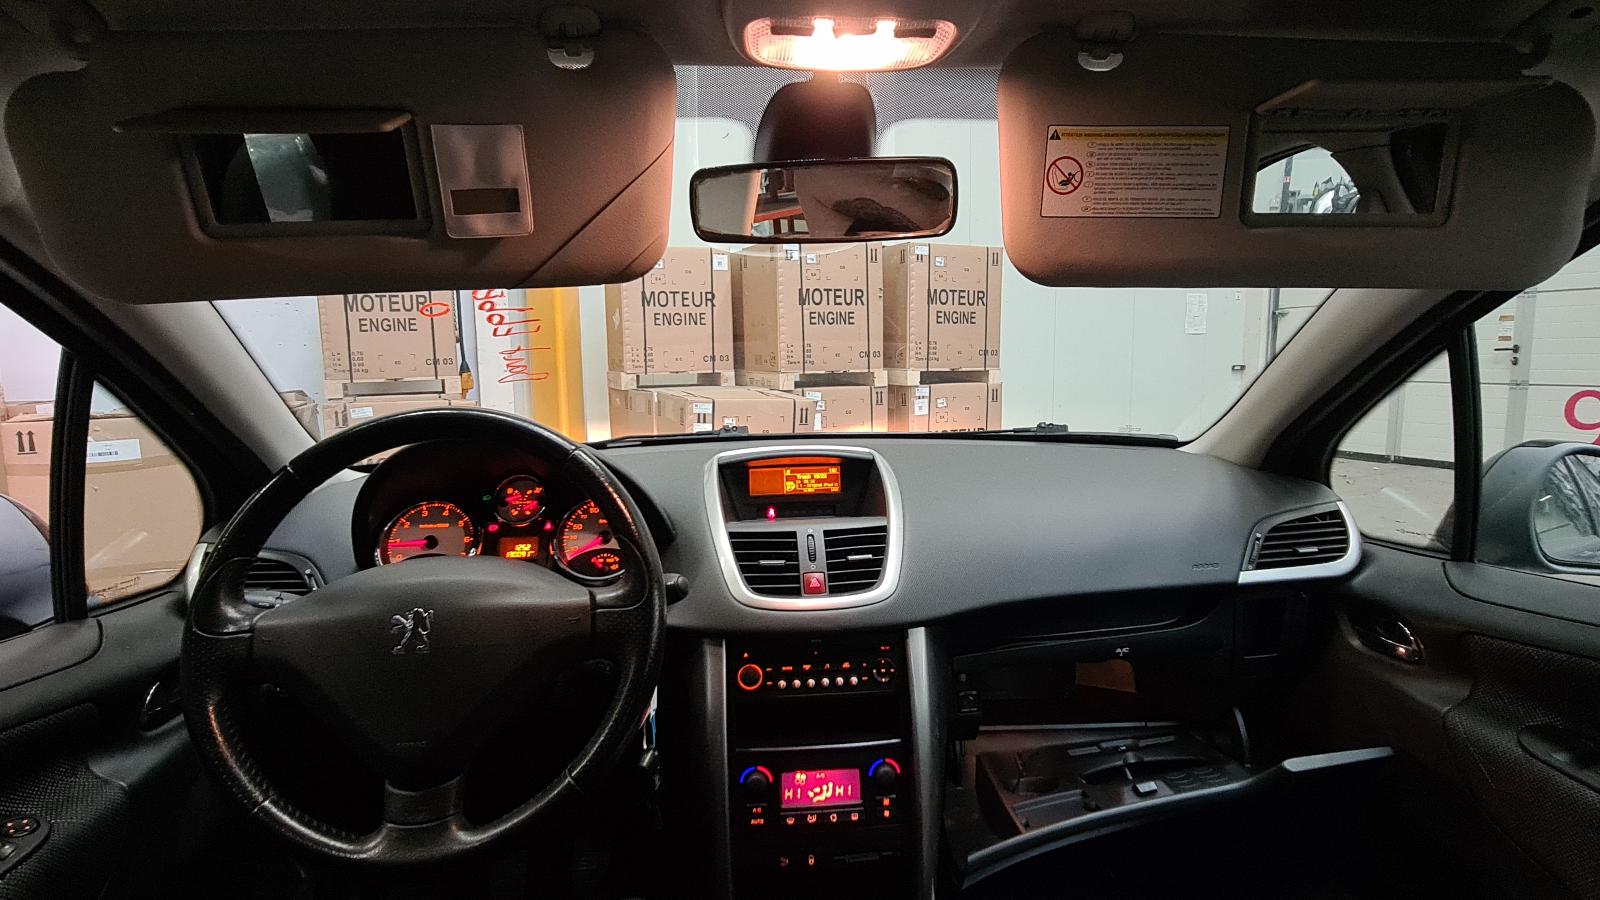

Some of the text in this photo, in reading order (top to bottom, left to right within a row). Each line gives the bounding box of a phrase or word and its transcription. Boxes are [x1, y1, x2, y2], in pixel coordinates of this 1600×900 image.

[343, 294, 429, 313] MOTEUR
[641, 290, 716, 307] MOTEUR
[798, 287, 865, 306] MOTEUR
[927, 288, 986, 307] MOTEUR
[359, 317, 418, 333] ENGINE
[653, 312, 707, 326] ENGINE
[809, 311, 856, 326] ENGINE
[936, 310, 977, 325] ENGINE
[990, 349, 998, 357] 03
[443, 358, 454, 366] 03
